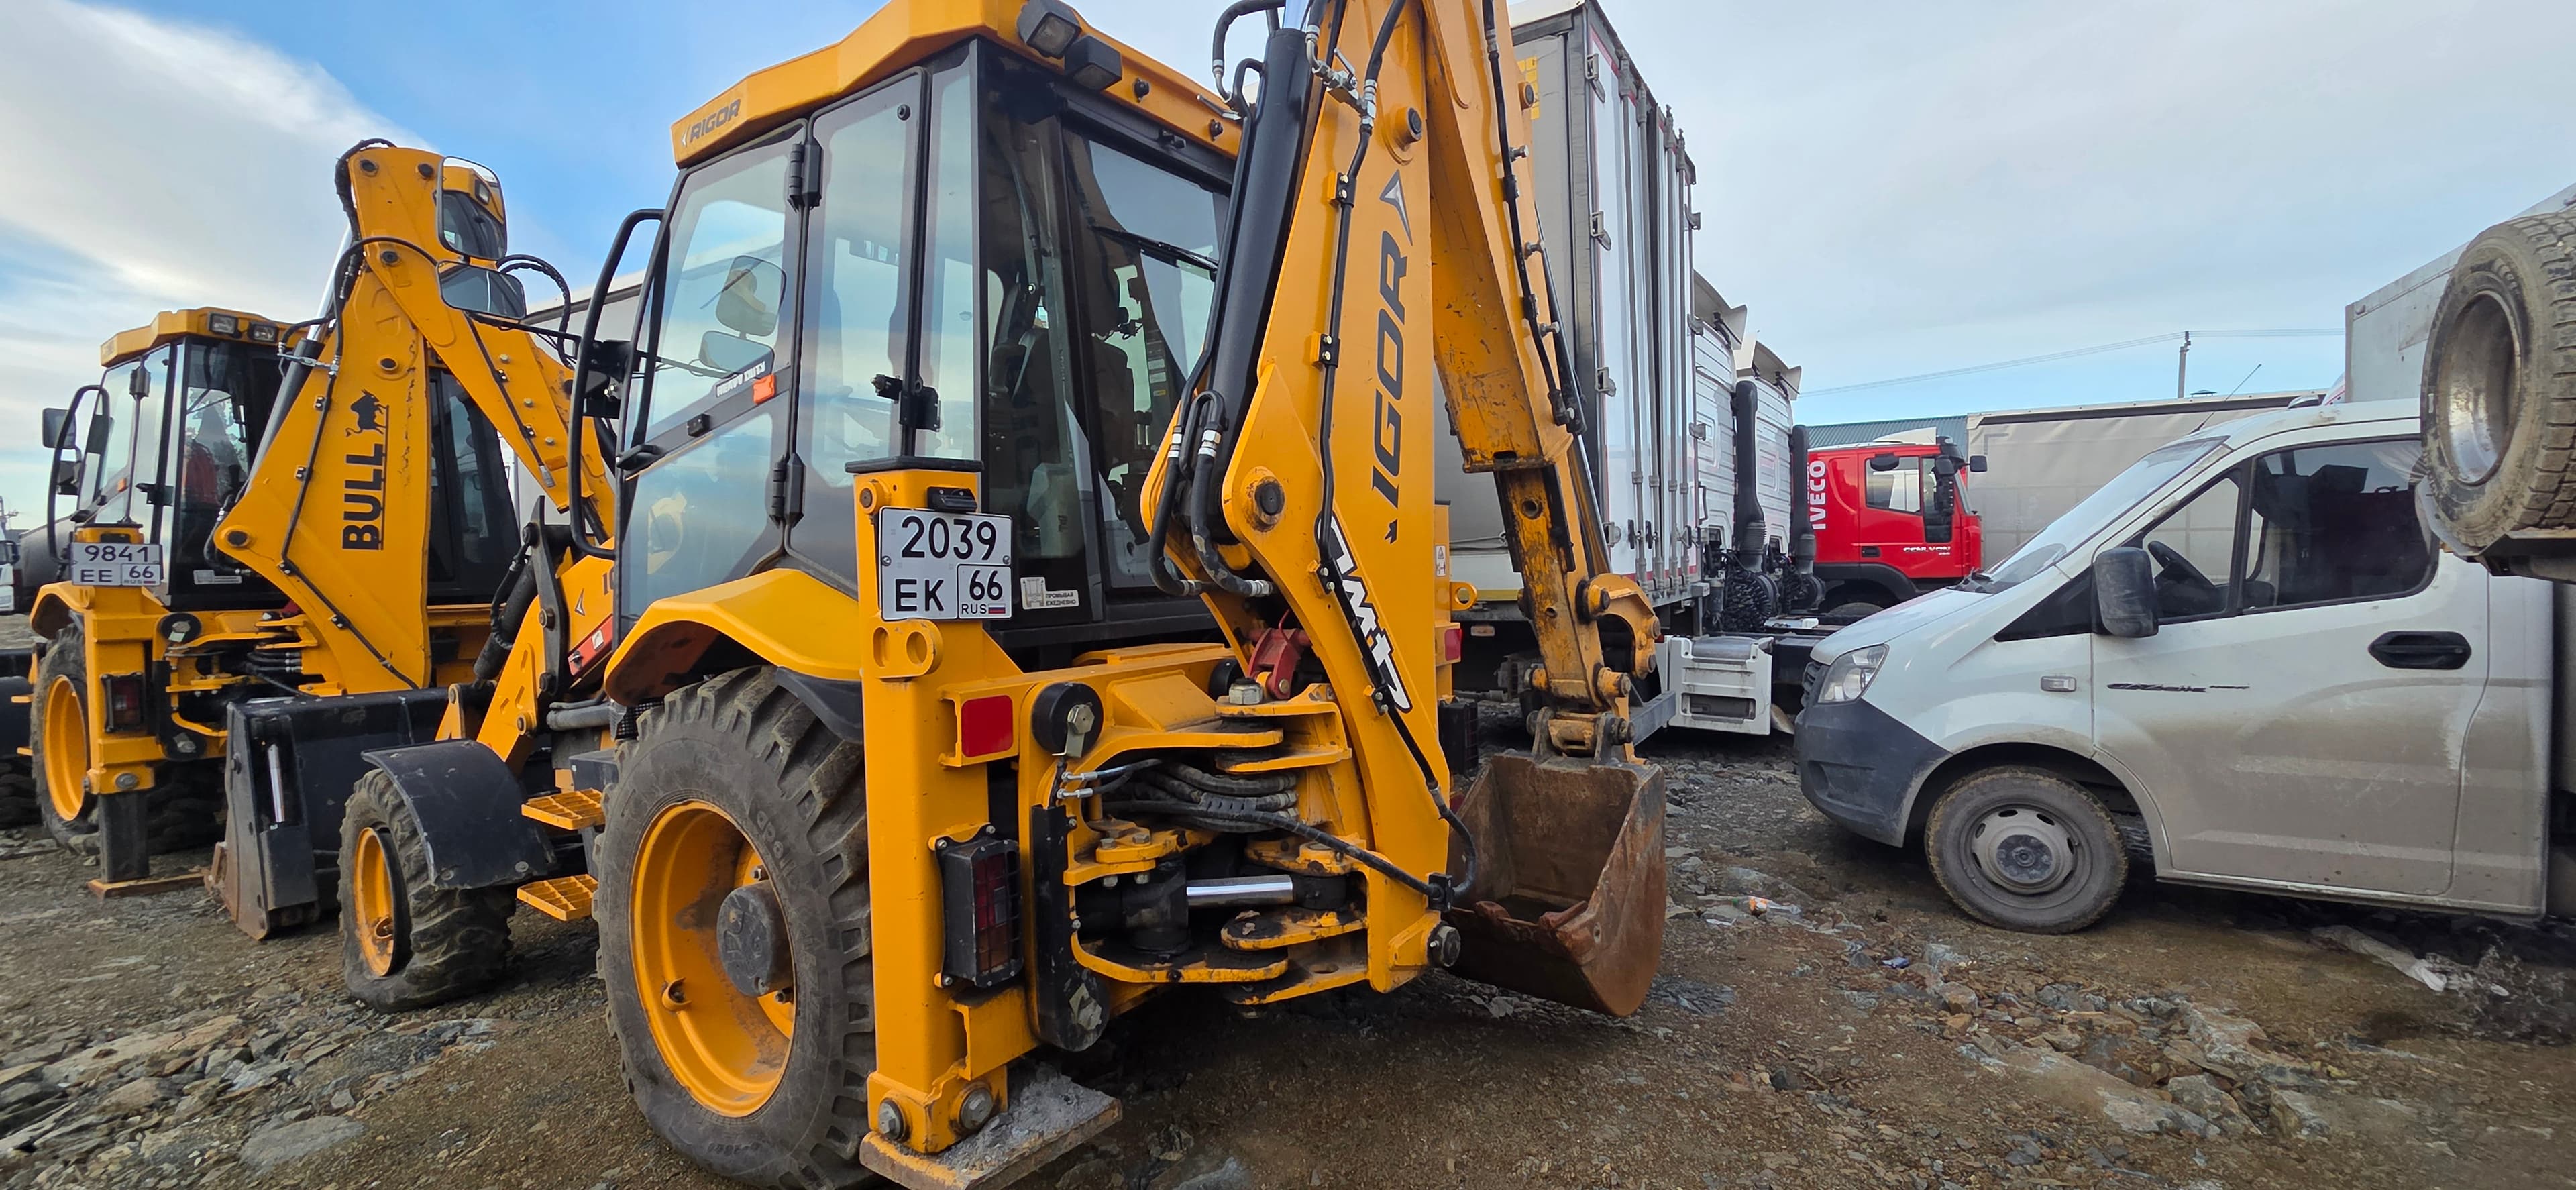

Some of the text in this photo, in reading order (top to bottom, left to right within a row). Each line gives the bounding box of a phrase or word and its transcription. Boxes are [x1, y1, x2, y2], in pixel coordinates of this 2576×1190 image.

[689, 98, 741, 143] RIGOR
[342, 443, 384, 549] BULL
[1809, 460, 1827, 530] IVECO
[84, 545, 148, 562] 9841
[901, 515, 997, 561] 2039
[129, 565, 154, 579] 66
[969, 570, 1003, 601] 66
[961, 604, 987, 614] RUS
